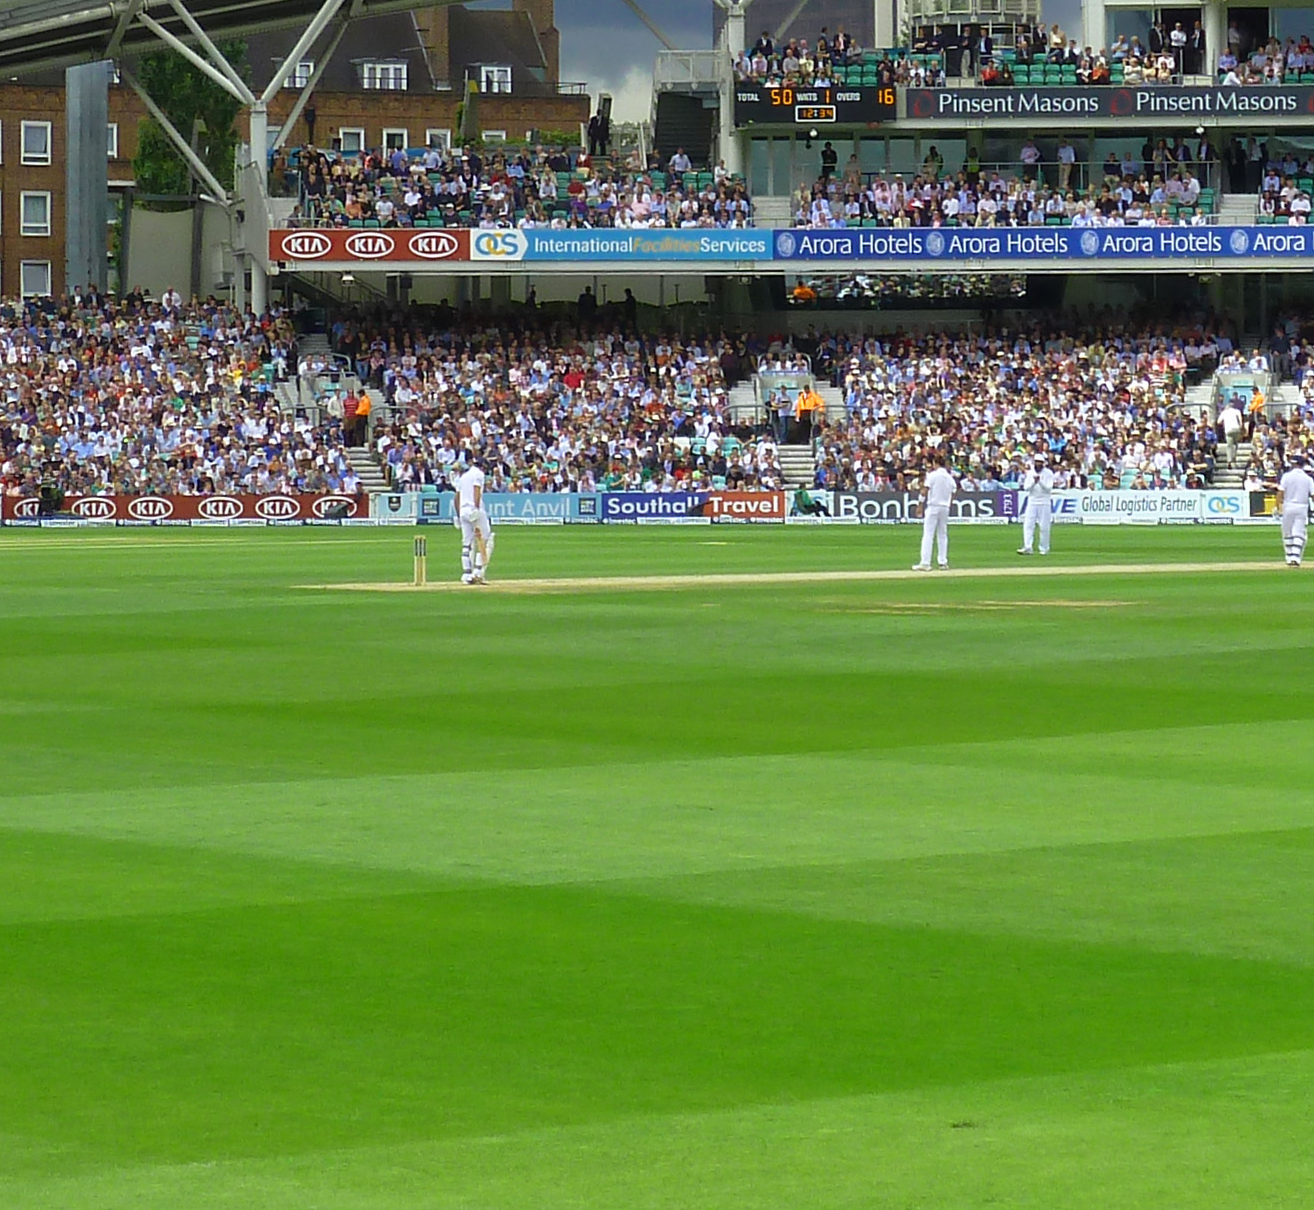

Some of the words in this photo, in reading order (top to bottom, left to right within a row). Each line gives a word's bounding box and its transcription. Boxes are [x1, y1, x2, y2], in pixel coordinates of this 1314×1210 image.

[737, 93, 760, 102] TOTAL
[770, 89, 793, 105] 50
[825, 89, 830, 104] 1
[837, 92, 861, 101] OVERS
[878, 88, 895, 105] 16
[939, 93, 1014, 113] Pinsent
[1018, 93, 1099, 112] Masons
[1137, 91, 1211, 111] Pinsent
[1215, 90, 1297, 111] Masons
[290, 238, 324, 252] KIA
[353, 238, 387, 252] KIA
[417, 238, 450, 252] KIA
[474, 232, 520, 256] OCS
[534, 237, 633, 253] International
[700, 237, 766, 253] Services
[799, 236, 851, 255] Arora
[859, 233, 922, 254] Hotels
[949, 235, 1000, 253] Arora
[1007, 233, 1067, 253] Hotels
[1102, 234, 1153, 252] Arora
[1161, 232, 1221, 252] Hotels
[1253, 232, 1305, 251] Arora
[22, 505, 41, 518] KI
[79, 502, 110, 517] KIA
[137, 502, 166, 516] KIA
[206, 501, 237, 516] KIA
[263, 501, 293, 515] KIA
[523, 497, 570, 517] Anvil
[608, 495, 700, 516] Southall
[709, 495, 779, 514] Travel
[840, 494, 994, 518] Bonhms
[1004, 493, 1013, 515] 1793
[1082, 495, 1114, 512] Global
[1116, 495, 1158, 517] Logistics
[1161, 496, 1197, 512] Partner
[1208, 496, 1240, 515] OCS
